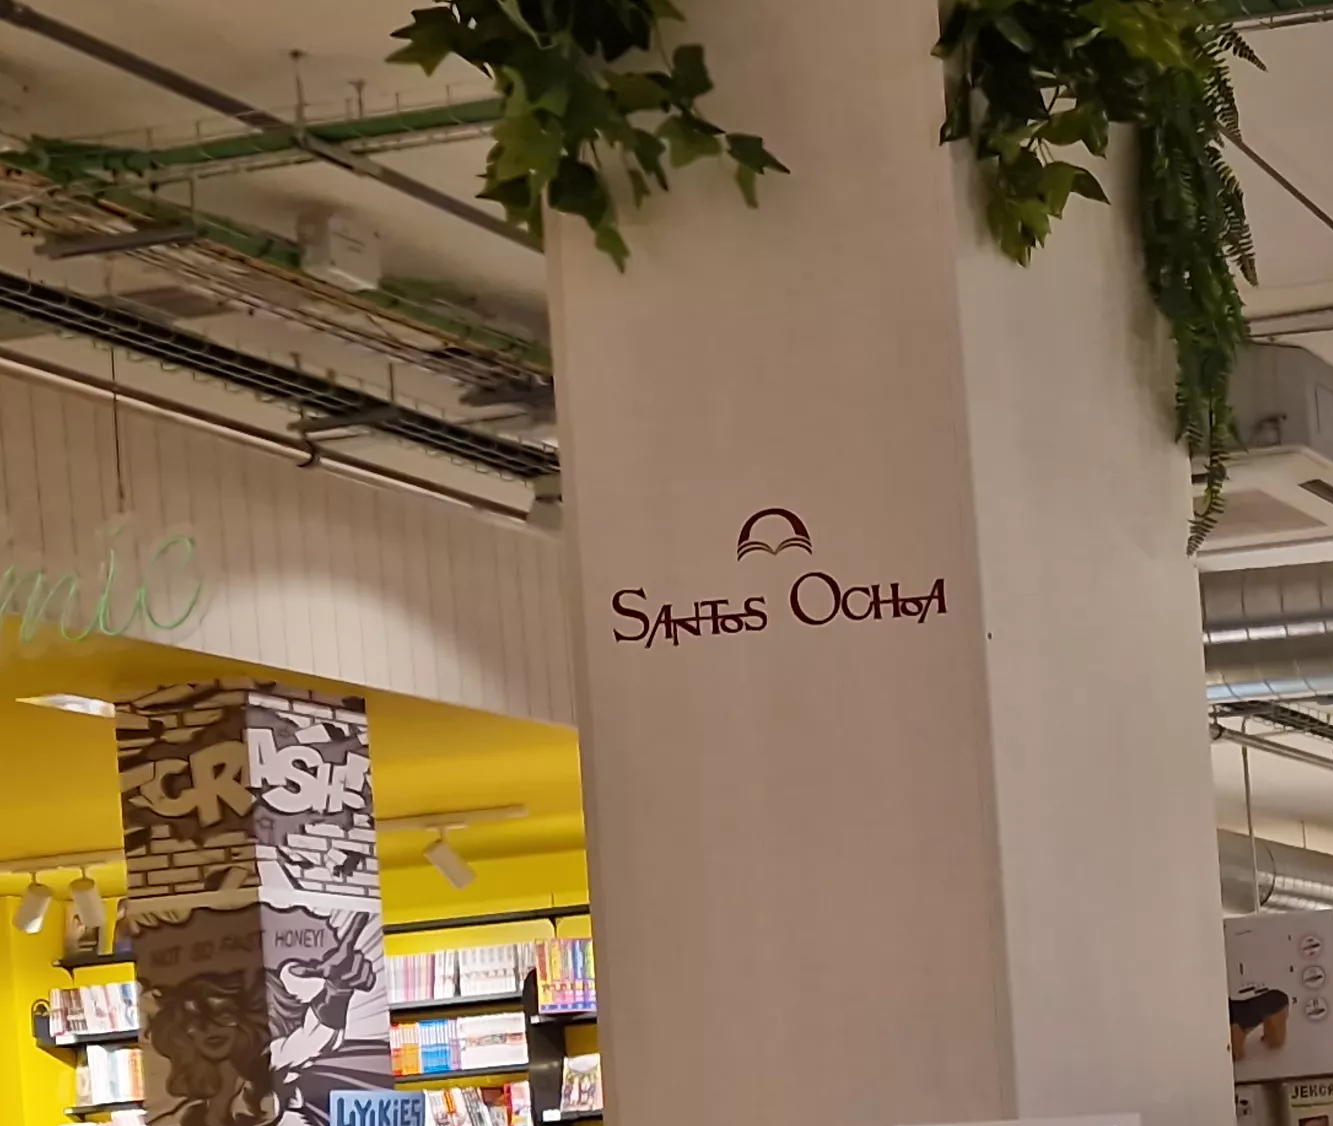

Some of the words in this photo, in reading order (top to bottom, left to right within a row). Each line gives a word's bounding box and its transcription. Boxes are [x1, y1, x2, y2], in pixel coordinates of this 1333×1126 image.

[612, 587, 768, 649] SANTOS
[789, 571, 948, 626] OCHOA
[274, 928, 325, 950] HONEY!
